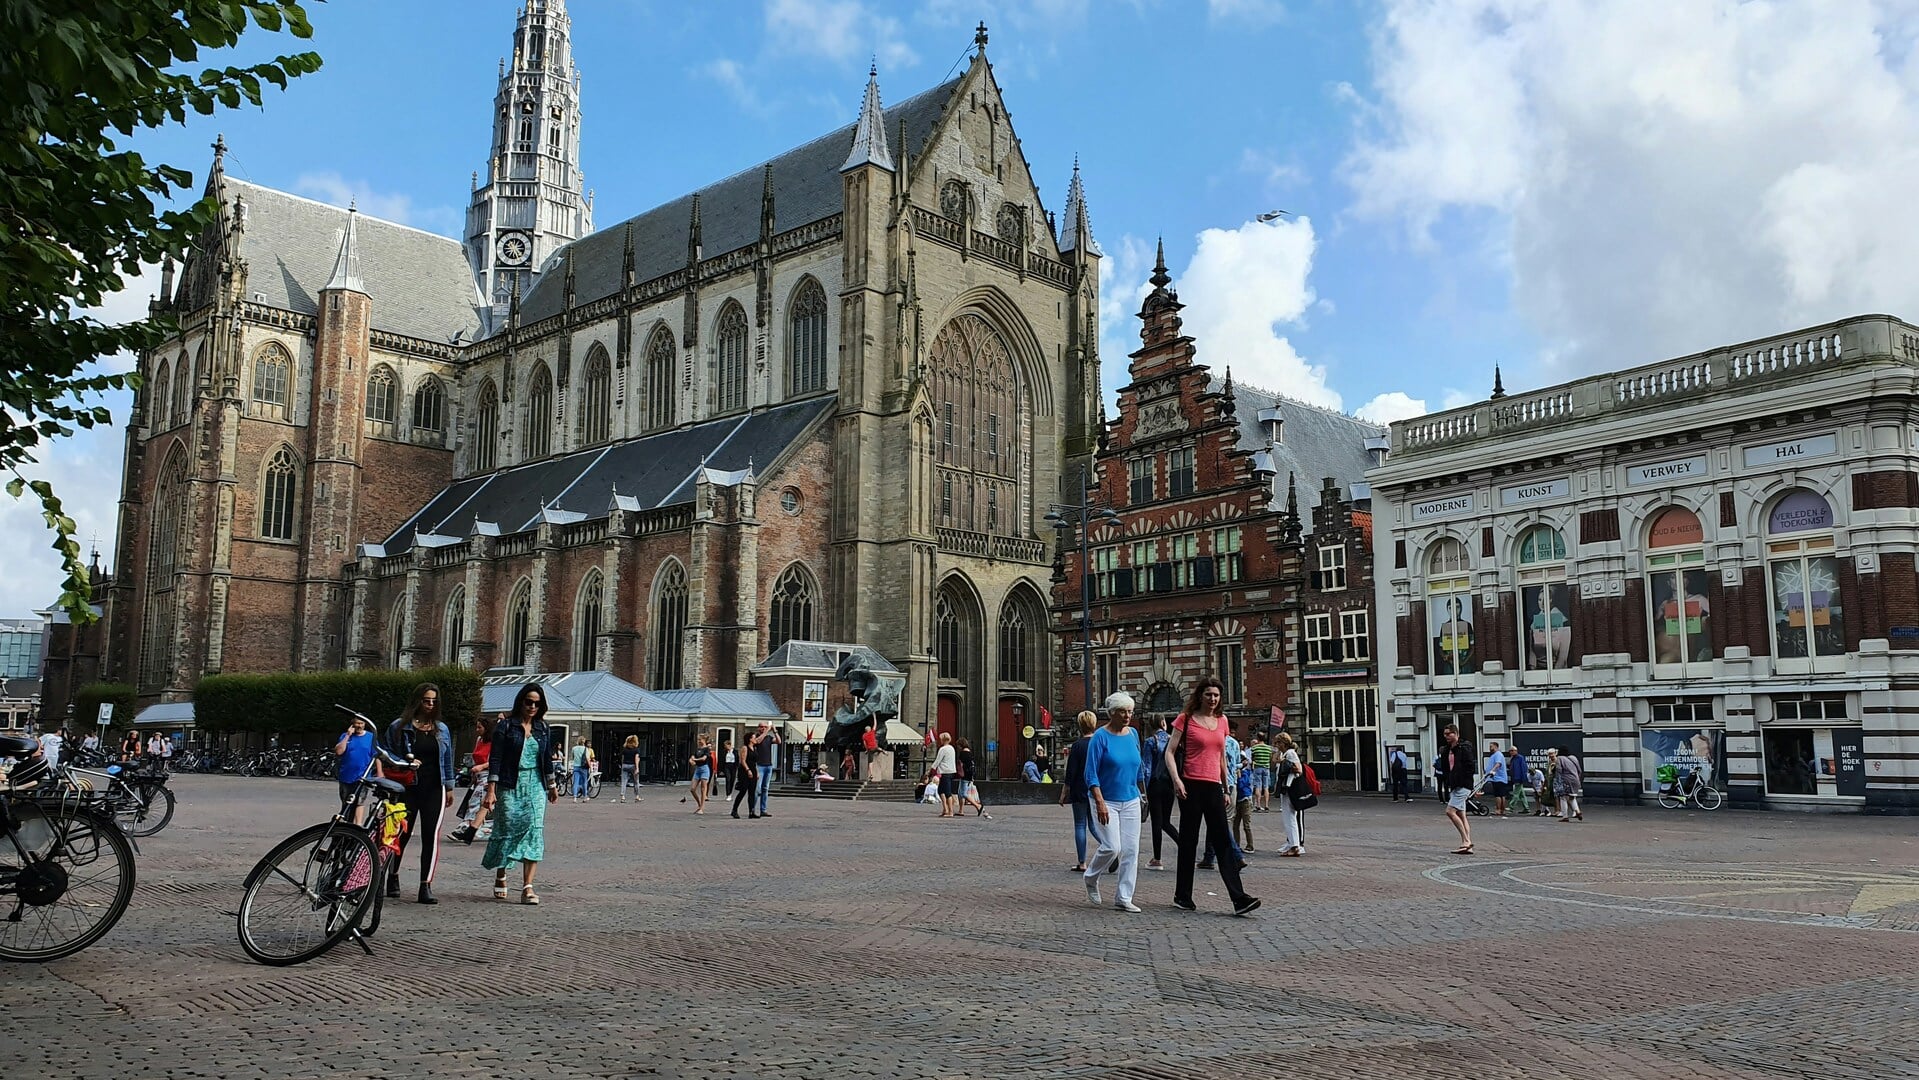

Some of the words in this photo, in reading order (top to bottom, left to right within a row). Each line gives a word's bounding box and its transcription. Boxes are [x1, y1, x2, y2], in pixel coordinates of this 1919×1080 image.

[1419, 500, 1468, 515] MODERNE
[1518, 485, 1553, 499] KUNST
[1642, 462, 1692, 479] VERWEY
[1775, 444, 1805, 458] HAL
[1774, 509, 1818, 522] VERLEDEN
[1818, 507, 1827, 517] &
[1780, 516, 1825, 529] TOEKOMST
[1653, 528, 1669, 536] OUD
